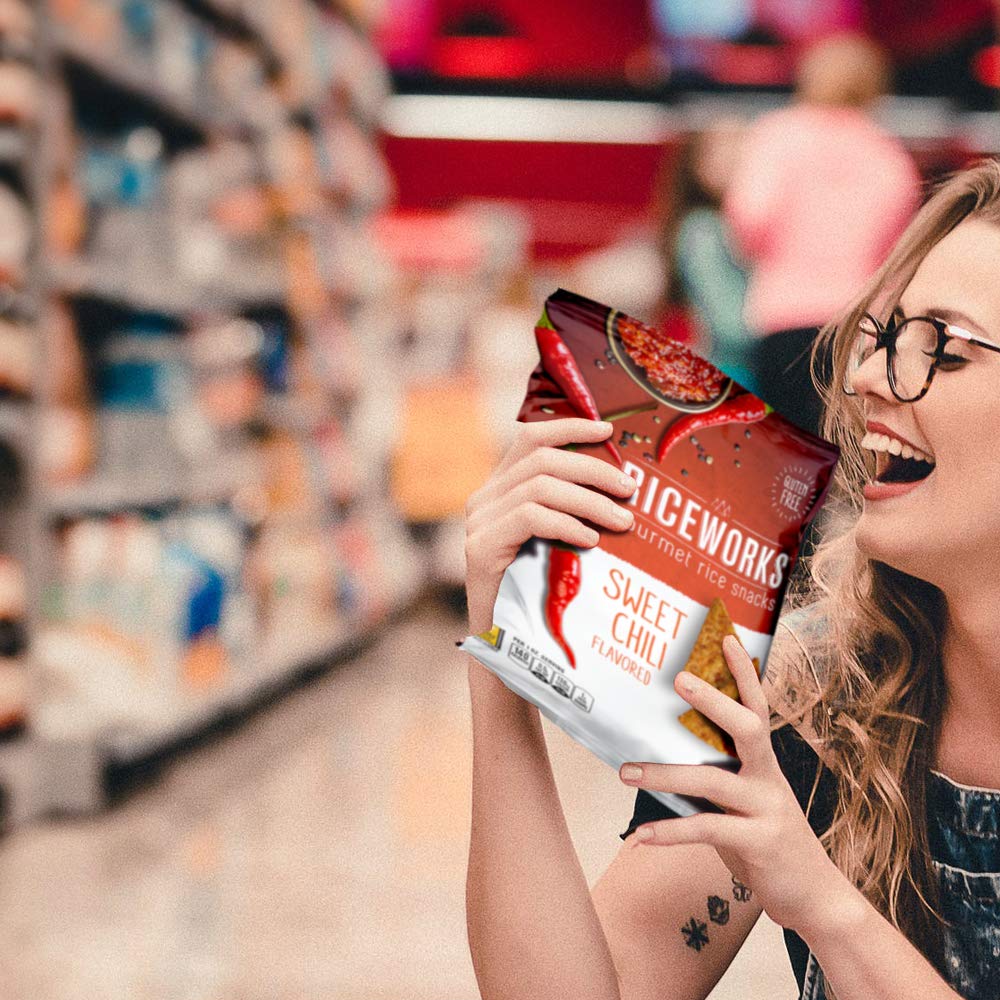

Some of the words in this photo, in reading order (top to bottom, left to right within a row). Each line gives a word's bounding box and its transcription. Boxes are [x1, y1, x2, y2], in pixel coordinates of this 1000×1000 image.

[780, 488, 802, 513] FREE
[783, 474, 810, 495] GLUTEN
[630, 519, 692, 567] urmet
[697, 560, 727, 589] rice
[731, 583, 776, 612] snacks
[603, 568, 688, 639] SWEET
[591, 635, 651, 687] FLAVORED
[611, 613, 669, 671] CHILI
